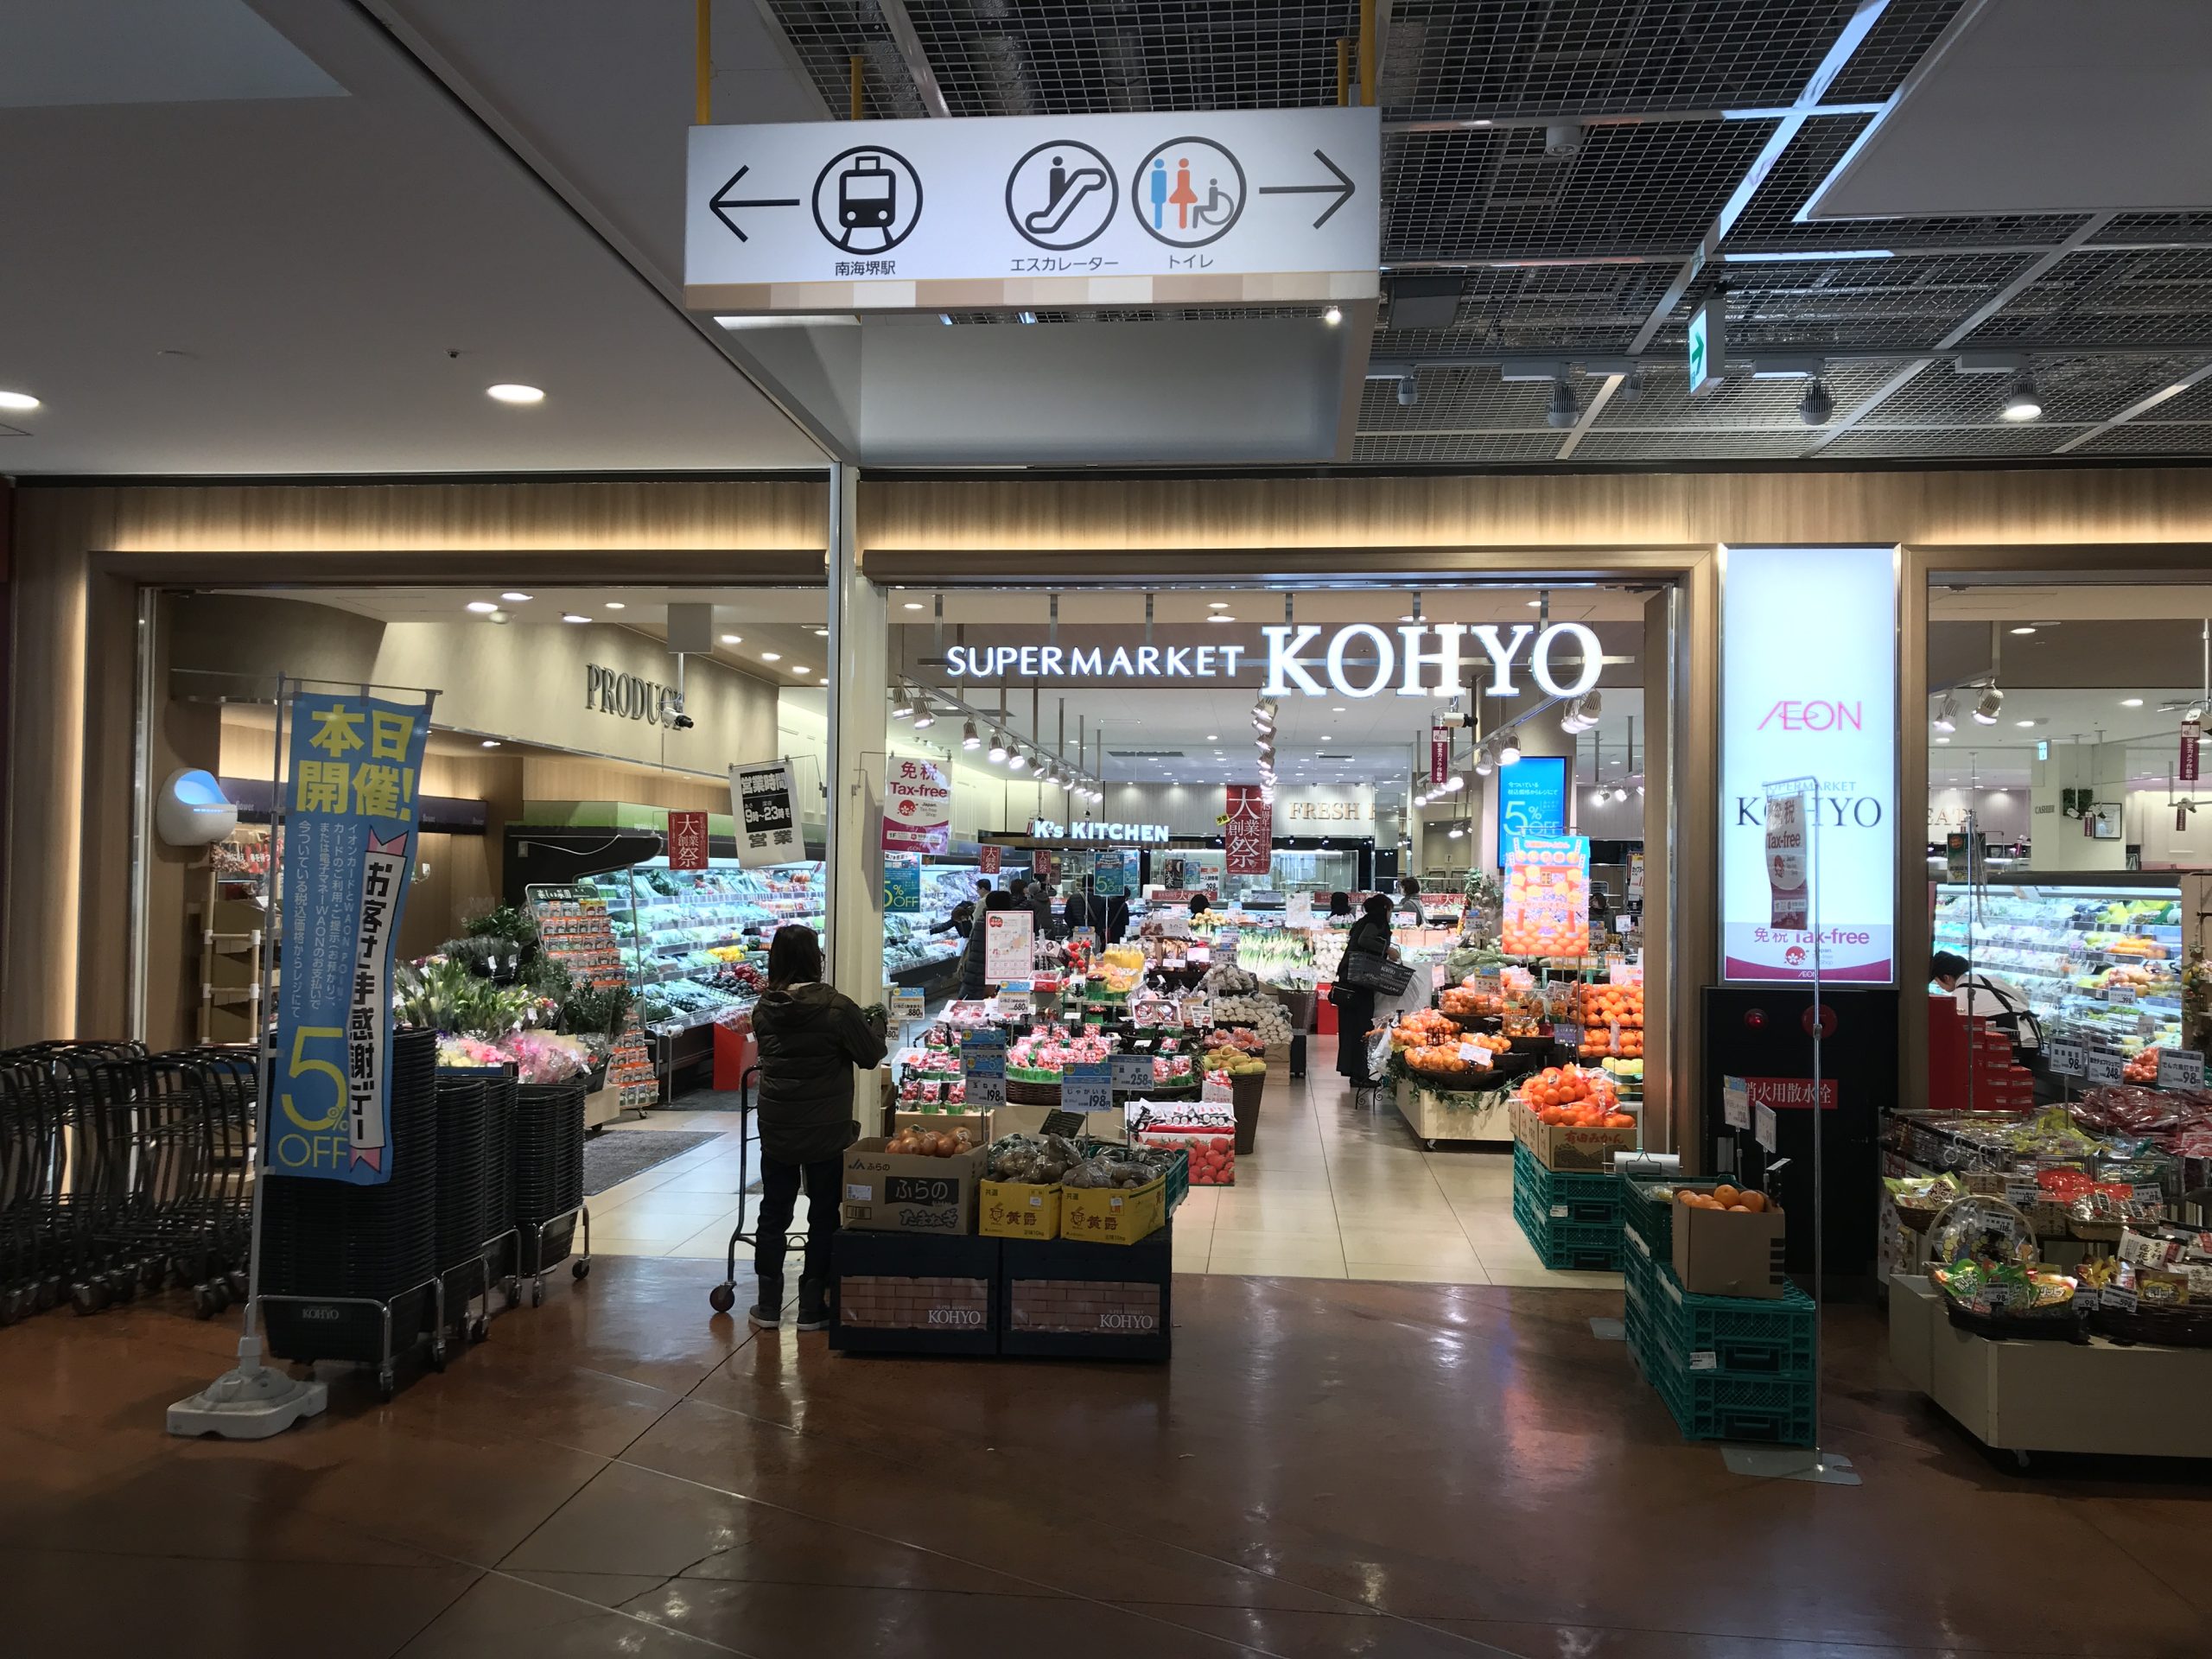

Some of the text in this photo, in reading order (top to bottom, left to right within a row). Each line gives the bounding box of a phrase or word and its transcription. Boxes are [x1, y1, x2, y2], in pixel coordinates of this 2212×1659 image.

[835, 260, 897, 276] 南海堺駅
[1010, 257, 1119, 271] エスカレーター
[1168, 254, 1213, 270] トイレ
[1262, 622, 1605, 698] KOHYO
[585, 663, 684, 731] PRODUC
[308, 703, 416, 762] 本日
[899, 761, 938, 781] 免税
[741, 772, 789, 795] 営業時間
[890, 782, 948, 798] Tax-free
[1289, 803, 1360, 820] FRESH
[1735, 796, 1882, 828] KYO
[677, 814, 700, 868] 大創業祭
[1071, 822, 1169, 842] KITCHEN
[1767, 830, 1801, 849] Tax-free
[893, 897, 918, 907] OFF
[1565, 1130, 1624, 1145] 有田みかん
[277, 1134, 348, 1169] OFF
[867, 1161, 891, 1172] ふらの
[895, 1179, 949, 1200] ふらの
[899, 1208, 959, 1229] たまねぎ
[302, 1308, 340, 1319] KOHYO
[928, 1310, 982, 1325] KOHYO
[1100, 1314, 1154, 1329] KOHYO
